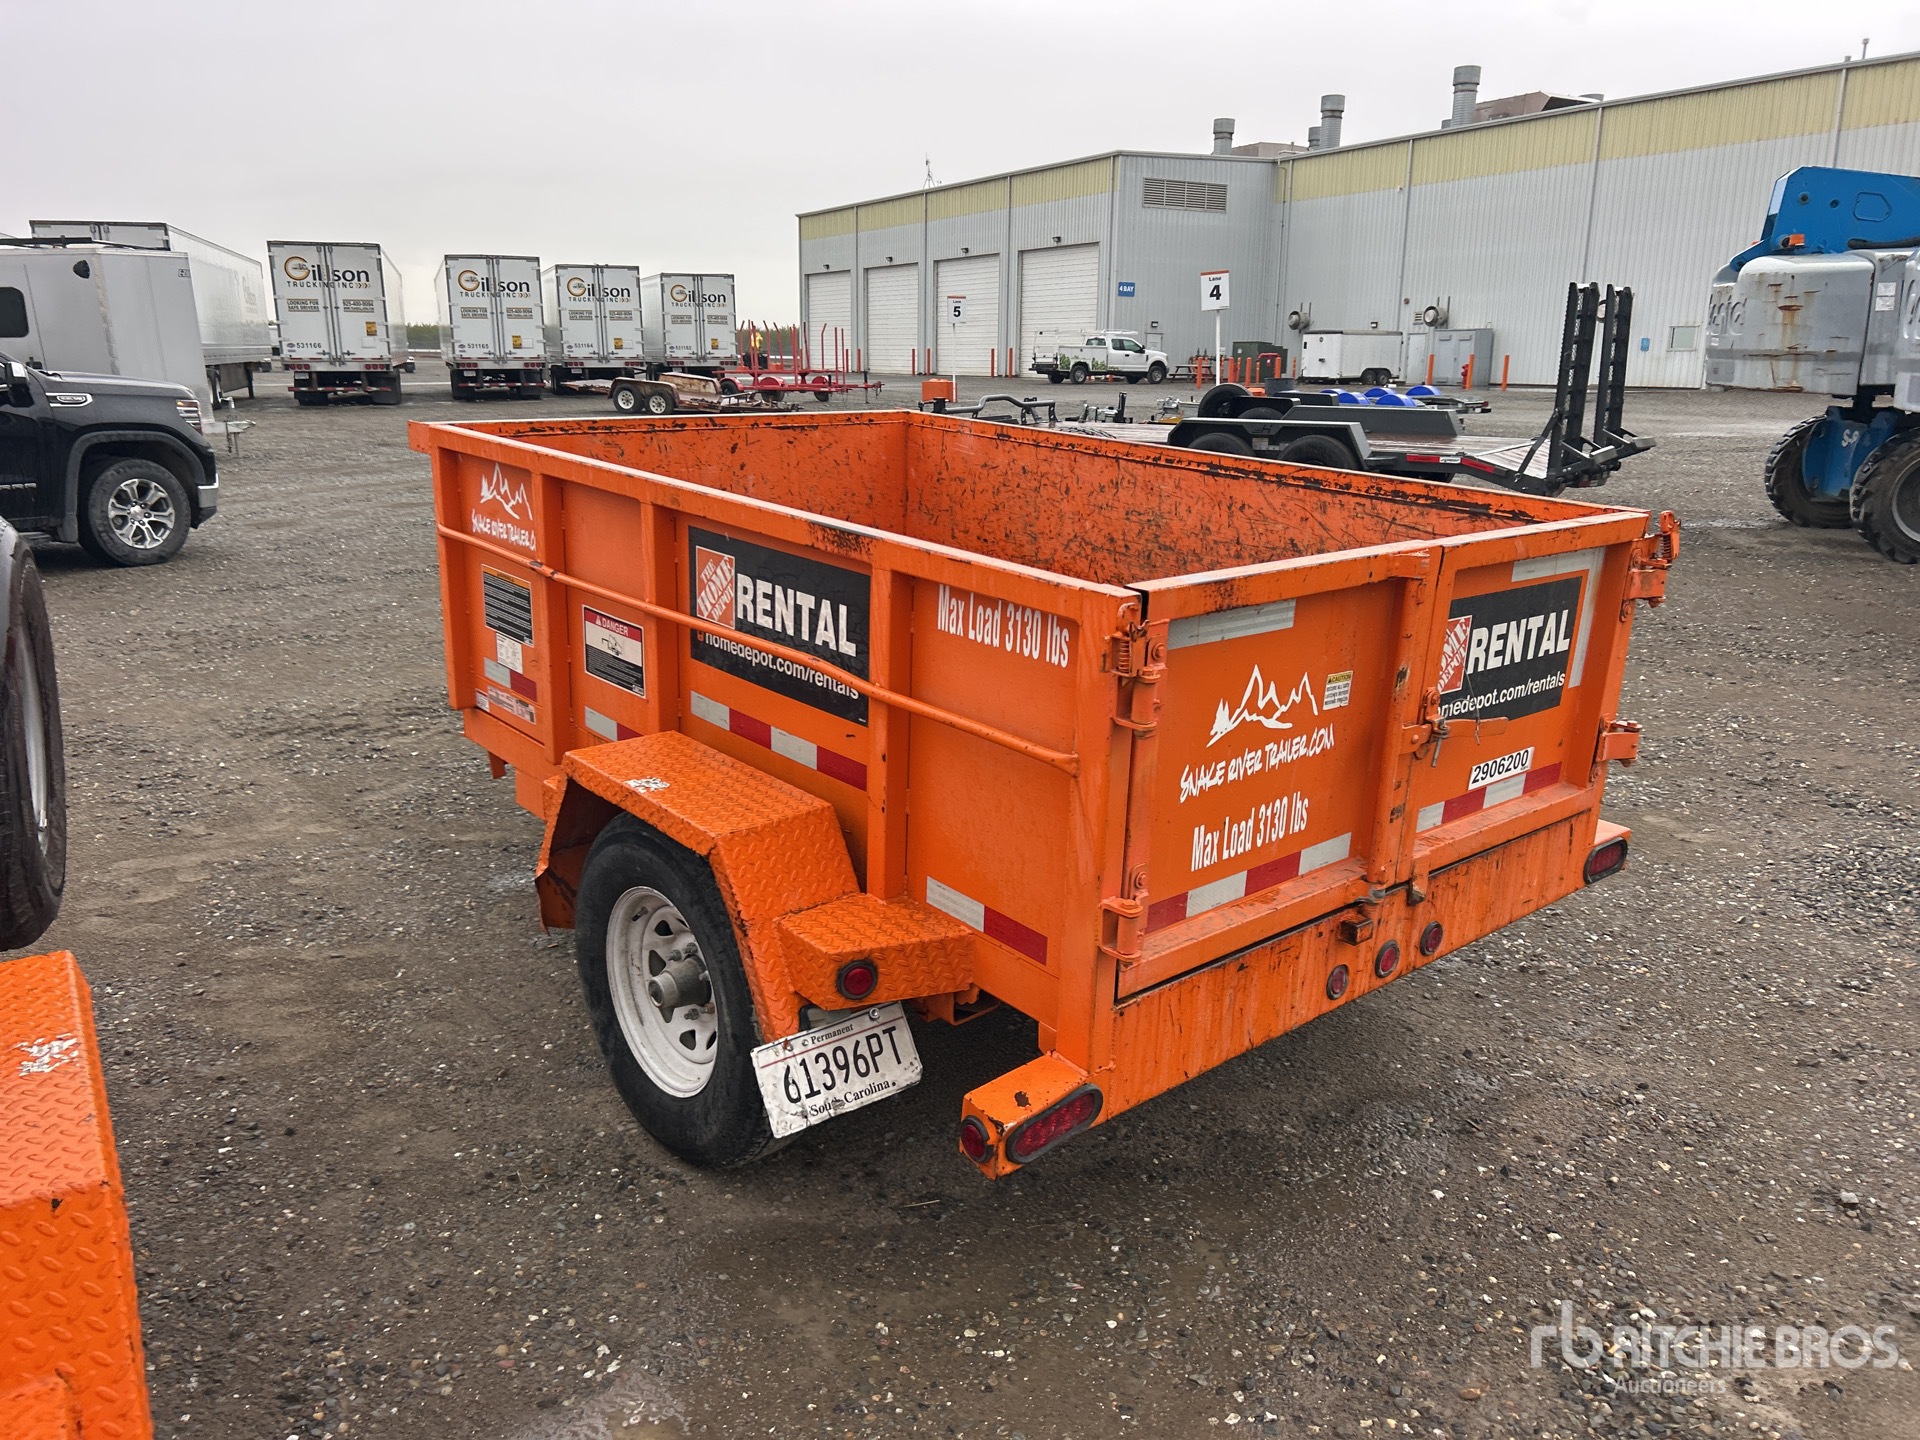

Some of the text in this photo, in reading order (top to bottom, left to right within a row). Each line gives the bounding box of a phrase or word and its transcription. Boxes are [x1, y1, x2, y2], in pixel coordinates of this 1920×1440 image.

[1209, 284, 1222, 301] 4
[953, 306, 961, 318] 5
[698, 555, 734, 617] HOME
[700, 559, 716, 584] THE
[711, 583, 734, 621] DEPOT
[736, 573, 857, 658] RENTAL
[602, 618, 629, 637] DANGER
[937, 583, 1070, 668] Max Load 3130 lbs
[1466, 609, 1570, 675] RENTAL
[1331, 673, 1352, 682] CAUTION
[1179, 722, 1335, 804] SNAKE RIVER TRAILER.COM
[1471, 749, 1530, 785] 2906200
[1190, 791, 1309, 872] Max Load 3130 lbs
[810, 1024, 854, 1045] Permanent
[783, 1025, 902, 1105] 61396PT
[843, 1080, 891, 1103] Carolina
